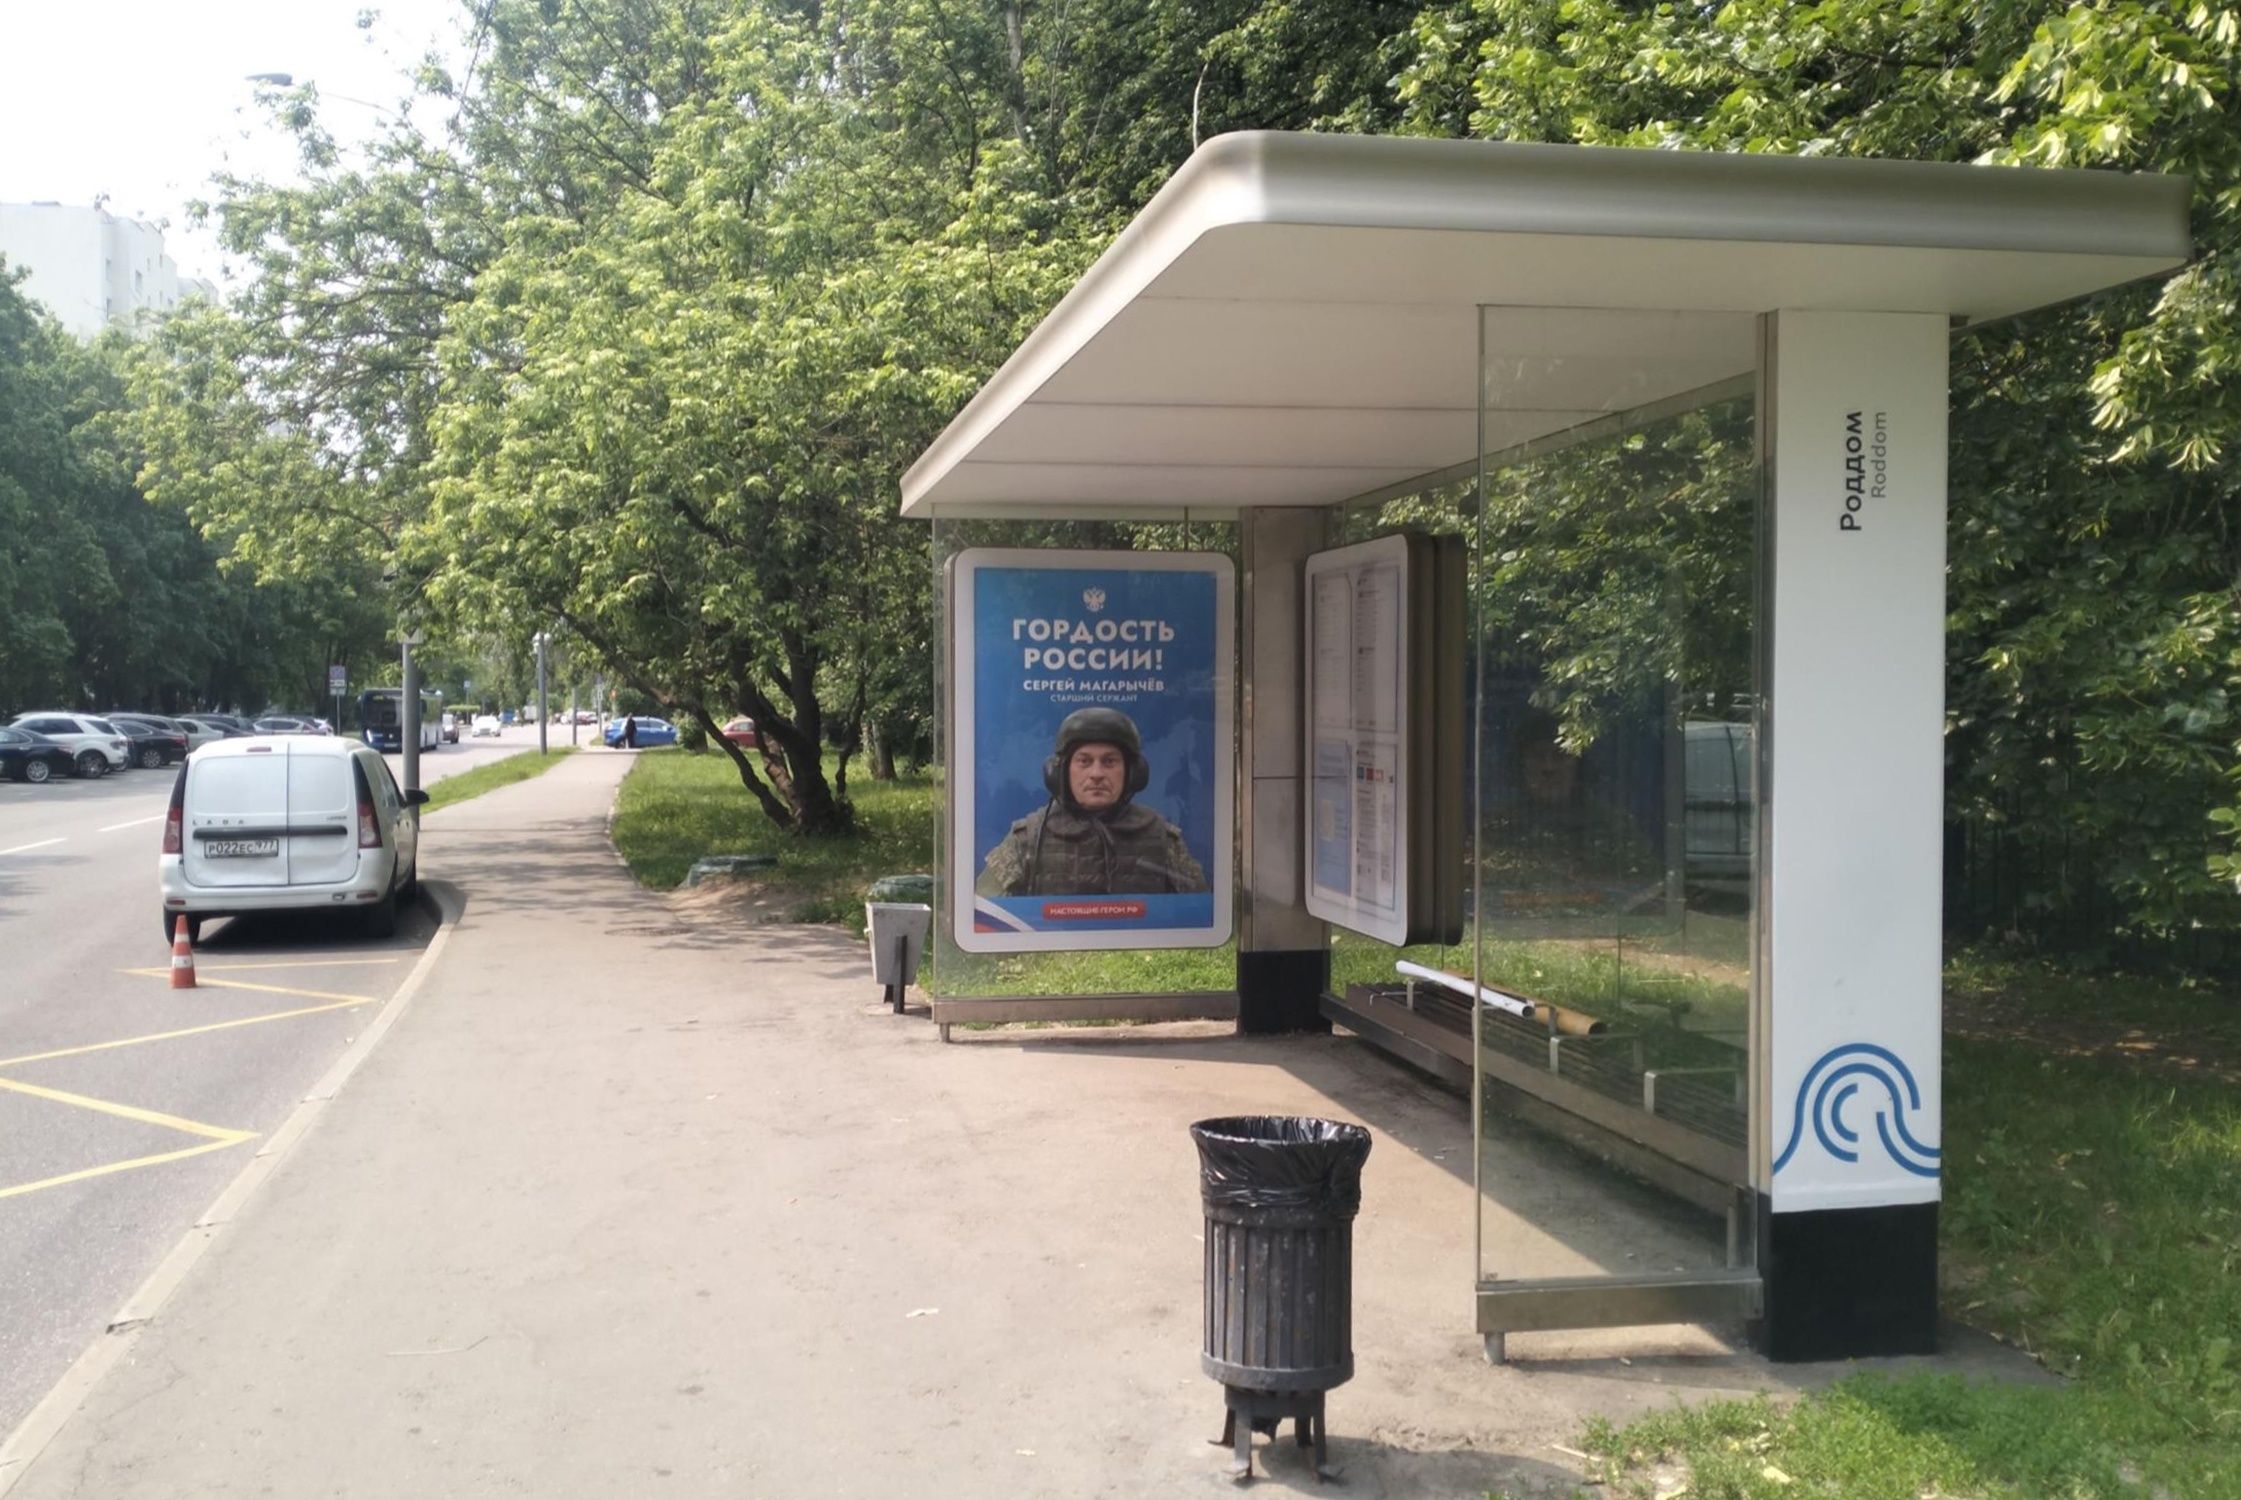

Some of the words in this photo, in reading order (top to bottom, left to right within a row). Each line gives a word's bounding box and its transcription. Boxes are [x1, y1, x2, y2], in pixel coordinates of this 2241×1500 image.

[1871, 411, 1887, 498] Roddom
[1840, 411, 1866, 531] Роддом
[1012, 618, 1175, 645] ГОРДОСТЬ
[1024, 647, 1163, 671] РОССИИ!
[1023, 677, 1075, 691] СЕРГЕЙ
[1079, 677, 1165, 692] МАГАРЫЧЁВ
[1050, 694, 1095, 703] СТАРШИЙ
[1096, 694, 1138, 702] СЕРЖАНТ
